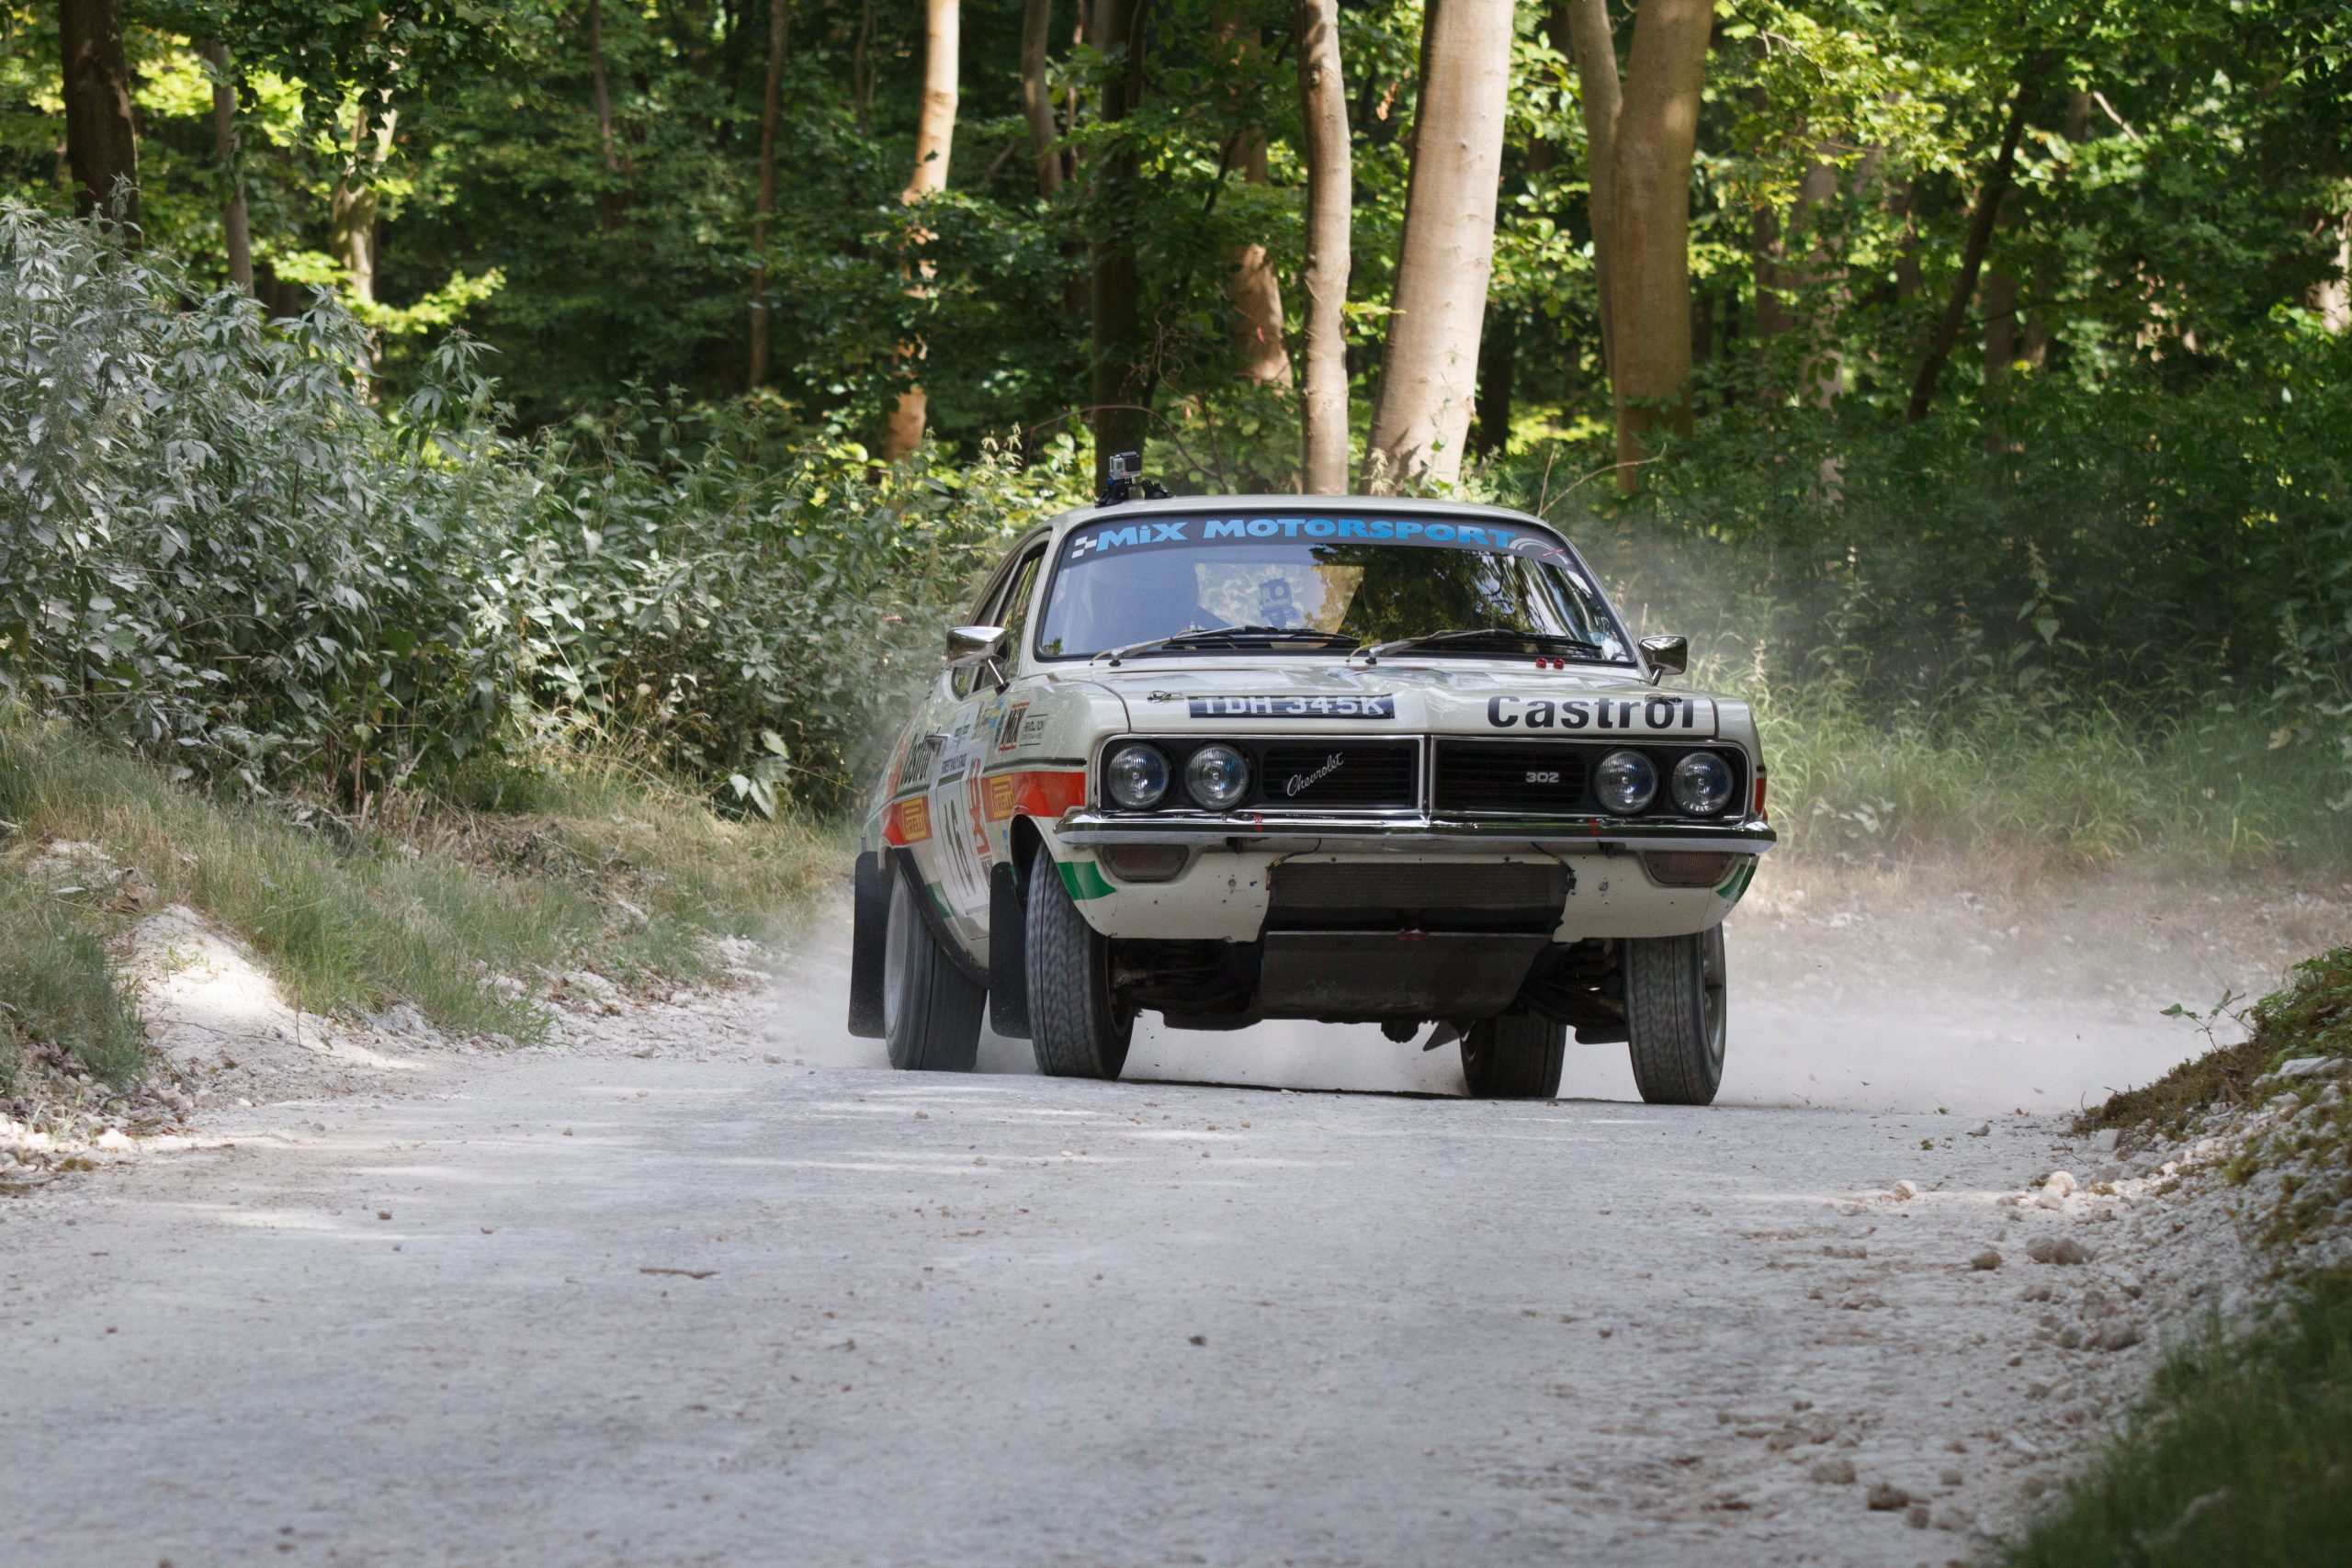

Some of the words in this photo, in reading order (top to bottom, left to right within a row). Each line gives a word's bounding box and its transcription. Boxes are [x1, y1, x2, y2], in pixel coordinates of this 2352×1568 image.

[1096, 522, 1188, 551] MiX
[1203, 519, 1516, 548] MOTORSPORT
[1286, 695, 1385, 715] 345K
[1487, 695, 1694, 729] Castrol
[1287, 751, 1344, 796] Chevrolet
[1526, 772, 1559, 784] 302
